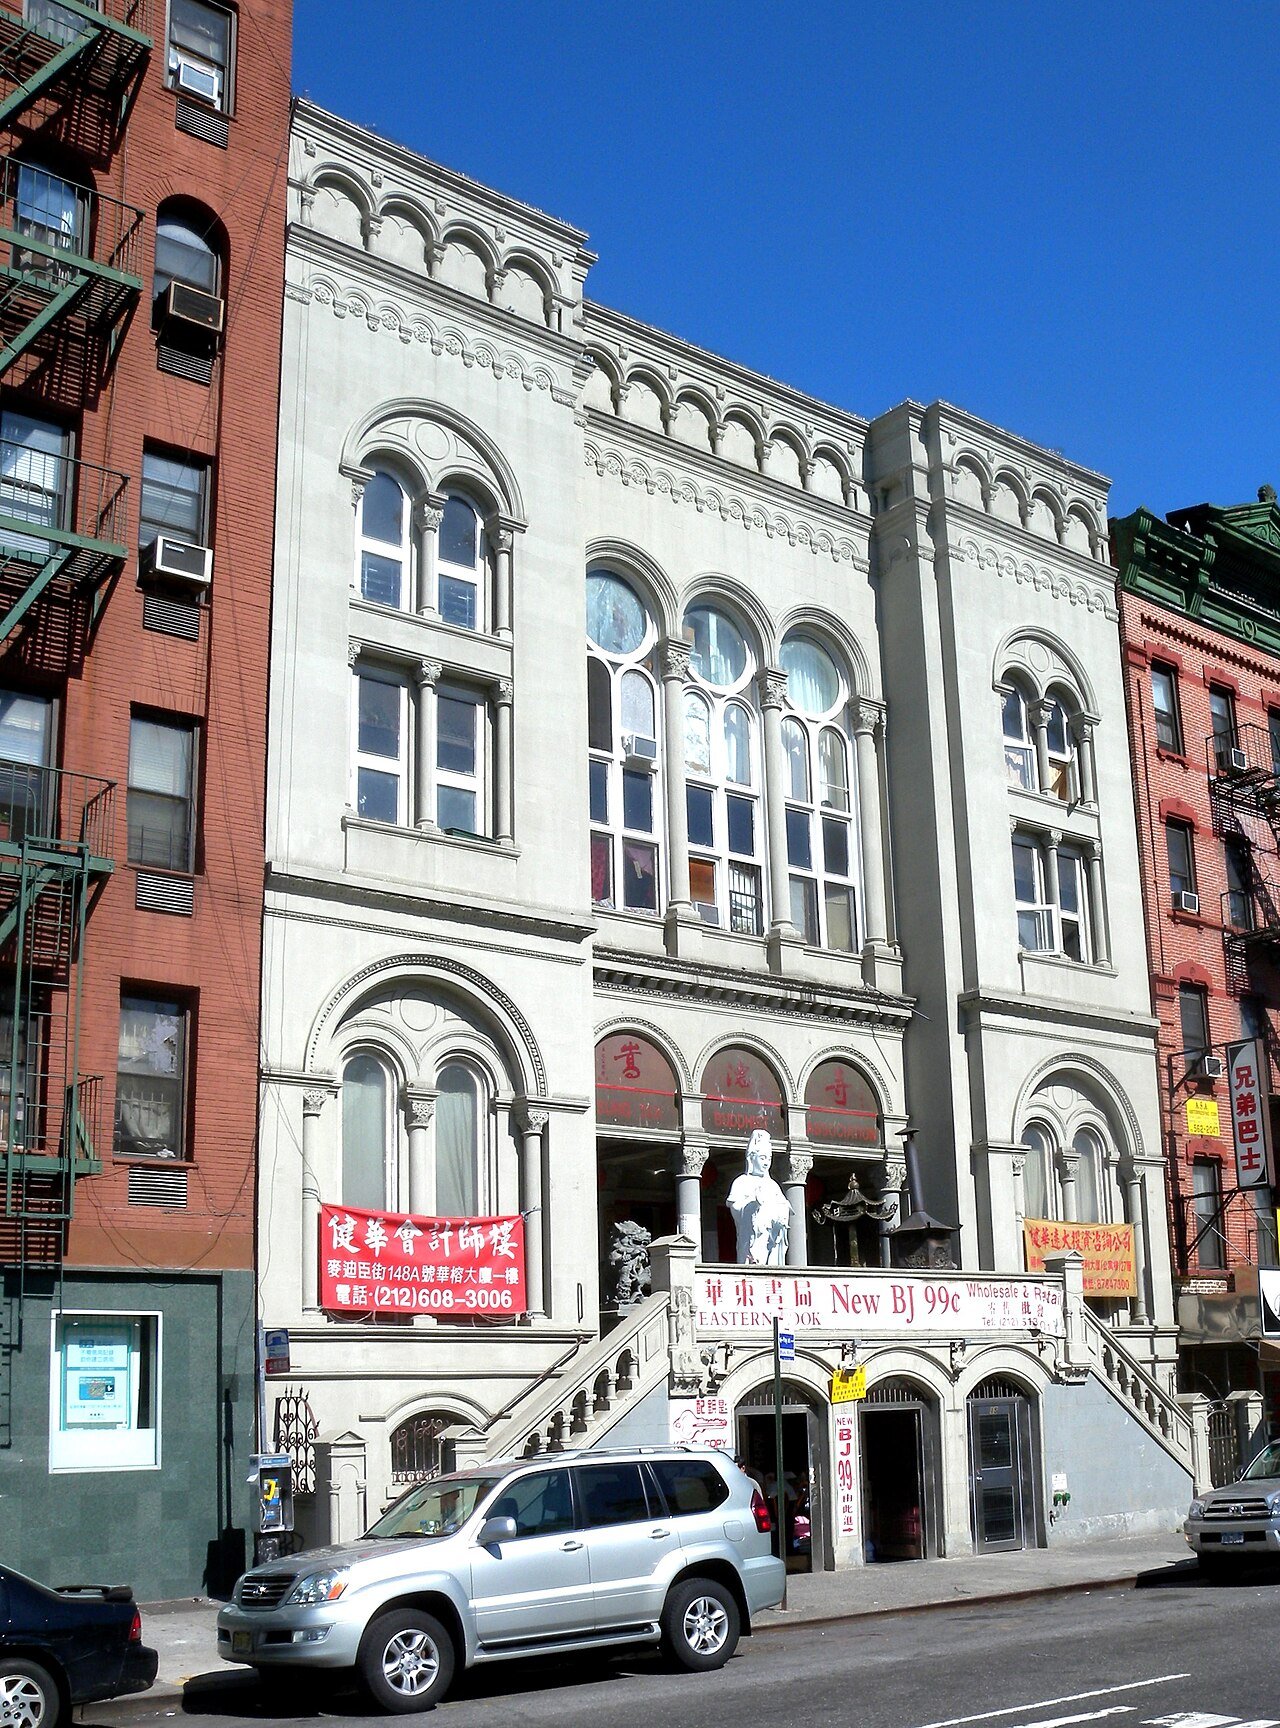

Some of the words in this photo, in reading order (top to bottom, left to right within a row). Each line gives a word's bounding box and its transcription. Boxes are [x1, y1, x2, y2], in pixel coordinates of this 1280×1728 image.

[1234, 1065, 1262, 1171] 兄弟巴士
[327, 1213, 519, 1260] 健華會計師樓
[830, 1284, 880, 1314] New
[890, 1285, 914, 1323] BJ
[966, 1283, 1018, 1299] Wholesale
[699, 1311, 772, 1326] EASTERN
[836, 1417, 853, 1426] NEW
